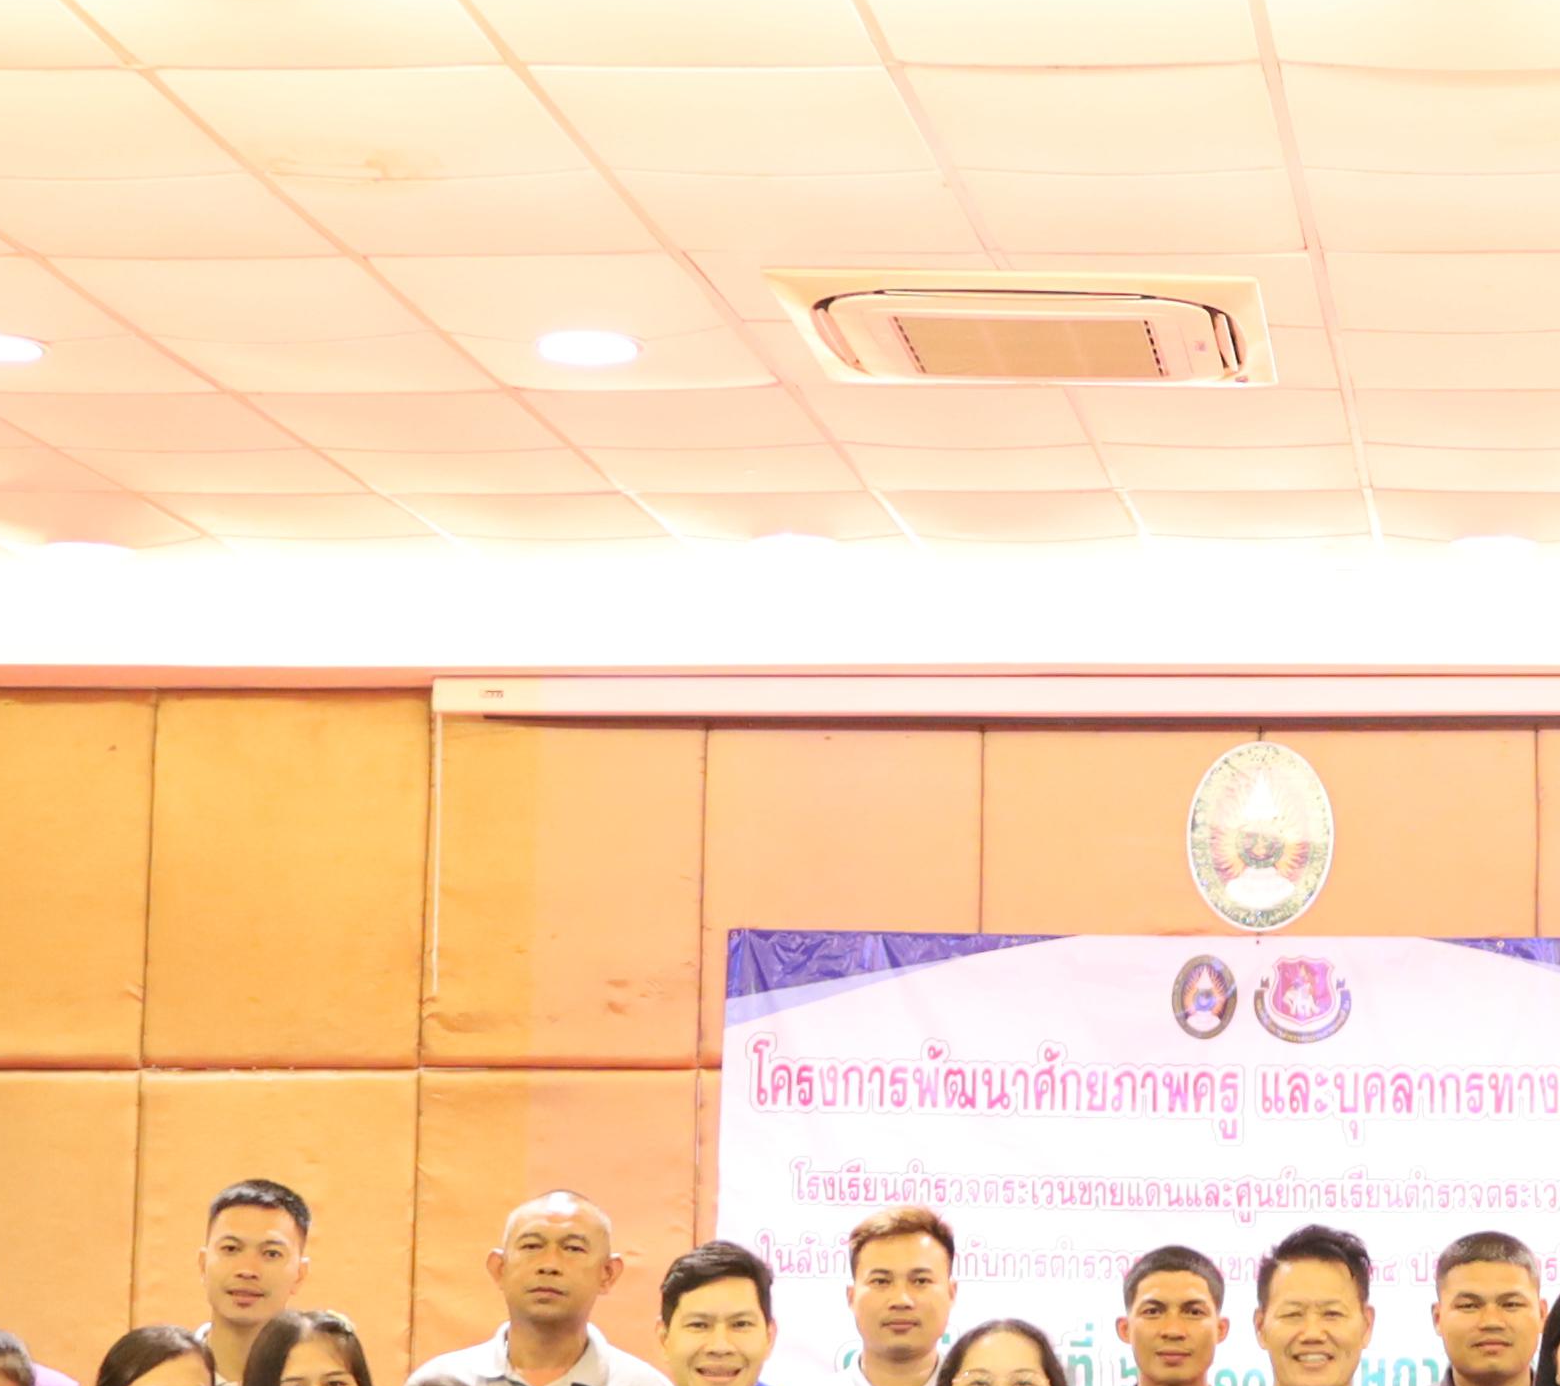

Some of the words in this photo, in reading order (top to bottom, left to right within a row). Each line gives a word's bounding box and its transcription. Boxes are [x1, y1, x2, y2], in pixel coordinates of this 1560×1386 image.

[751, 1038, 1240, 1140] โครงการพัฒนาศักยภาพครู
